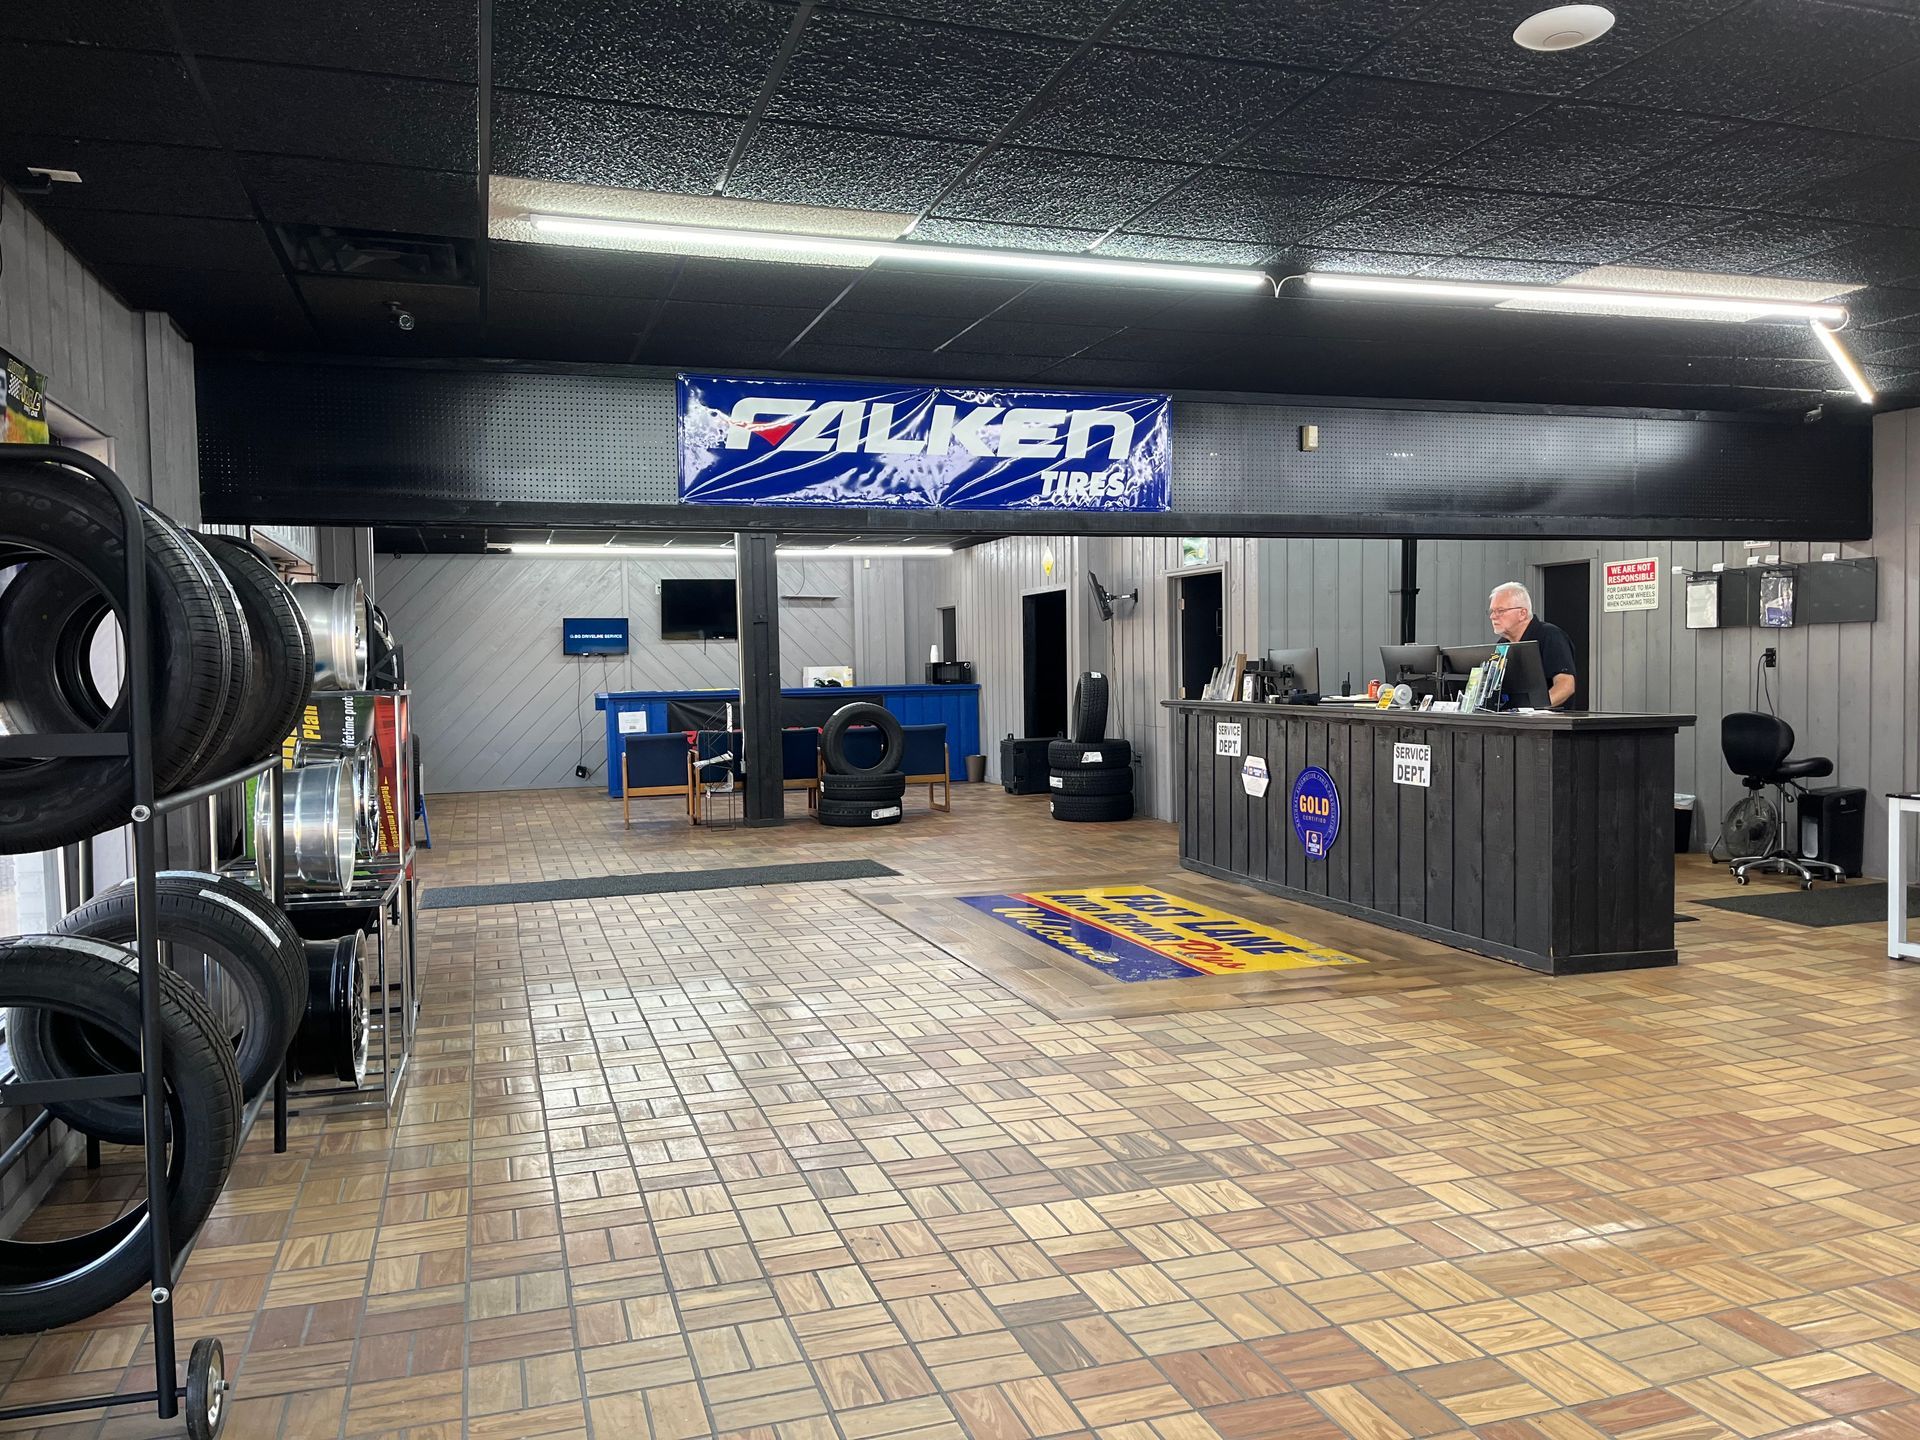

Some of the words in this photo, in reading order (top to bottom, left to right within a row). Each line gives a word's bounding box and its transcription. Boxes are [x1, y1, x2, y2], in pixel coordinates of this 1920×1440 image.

[723, 397, 1137, 460] FALKEN
[1040, 470, 1126, 497] TIRES
[1609, 572, 1654, 583] RESPONSIBLE
[1623, 565, 1636, 573] ARE
[1637, 563, 1651, 571] NOT
[1617, 585, 1636, 593] DAMAGE
[342, 695, 356, 715] prot
[342, 716, 355, 747] ifetime
[1218, 725, 1241, 736] SERVICE
[1219, 739, 1239, 754] DEPT.
[1395, 746, 1429, 761] SERVICE
[1397, 764, 1426, 784] DEPT.
[380, 785, 394, 814] Reduced
[1299, 794, 1330, 816] GOLD
[1302, 814, 1327, 824] CERTIFIED
[386, 814, 400, 849] emissions
[1043, 894, 1111, 912] AUTO
[1089, 912, 1186, 942] REPAIR
[1150, 939, 1247, 970] Plus
[1102, 894, 1206, 918] FAST
[1172, 920, 1309, 955] LANE
[991, 907, 1120, 964] Welcome
